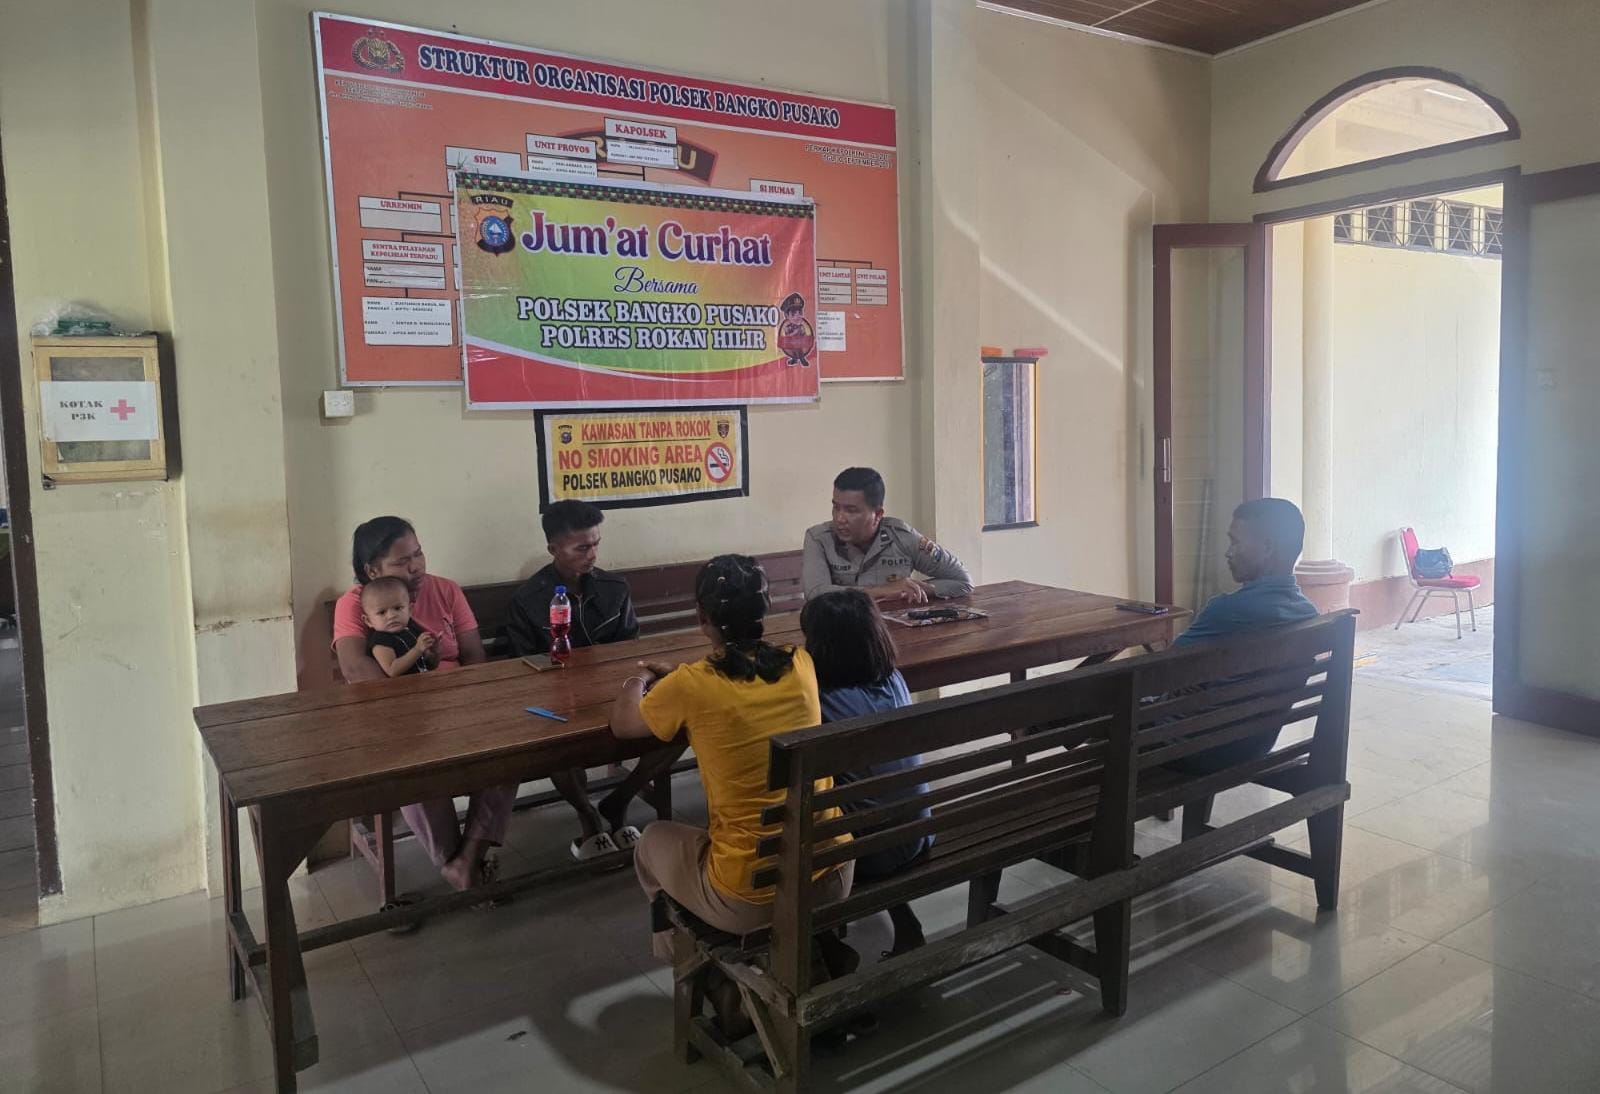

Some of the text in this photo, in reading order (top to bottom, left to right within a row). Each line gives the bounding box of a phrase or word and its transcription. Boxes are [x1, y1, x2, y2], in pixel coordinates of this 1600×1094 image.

[418, 45, 840, 128] STRUKTUR ORGANISASI POLSEK BANGKO PUSAKO
[615, 123, 668, 139] KAPOLSEK
[534, 140, 591, 154] UNIT PROVOS
[473, 154, 497, 165] SIUM
[768, 185, 795, 196] HUMAS
[380, 200, 423, 211] URRENMIN
[475, 196, 508, 205] RIAU
[521, 211, 649, 258] Jum'at
[658, 221, 773, 266] Curhat
[613, 267, 698, 294] Bersama
[518, 297, 780, 327] POLSEK BANGKO PUSAKO
[541, 324, 766, 350] POLRES ROKAN HILIR
[59, 400, 104, 409] KOTAK
[71, 413, 96, 421] P3K
[581, 419, 711, 442] KAWASAN TANPA ROKOK
[558, 444, 703, 470] NO SMOKING AREA
[563, 467, 702, 491] POLSEK BANGKO PUSAKO
